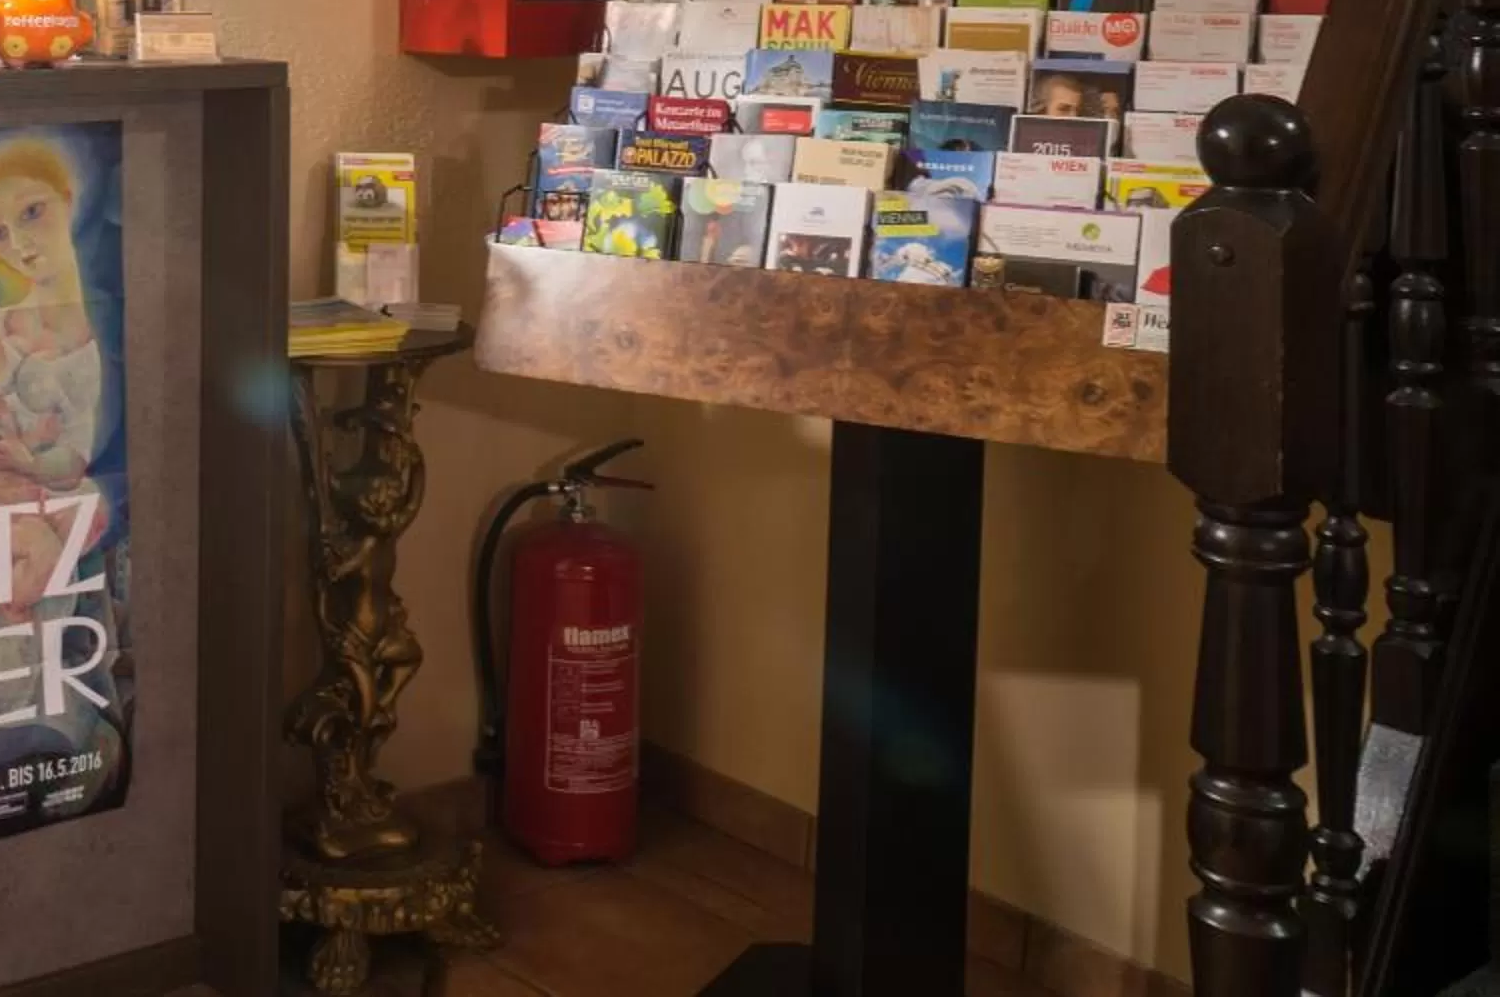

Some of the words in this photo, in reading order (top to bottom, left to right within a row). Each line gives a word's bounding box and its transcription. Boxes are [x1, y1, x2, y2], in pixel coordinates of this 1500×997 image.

[767, 9, 836, 39] MAK
[1050, 18, 1098, 36] Guide
[654, 102, 703, 118] Konzerte
[636, 148, 697, 168] PALAZZO
[1050, 160, 1089, 173] WIEN
[878, 211, 925, 224] VIENNA
[8, 765, 34, 789] BIS
[37, 750, 104, 783] 16.5.2016
